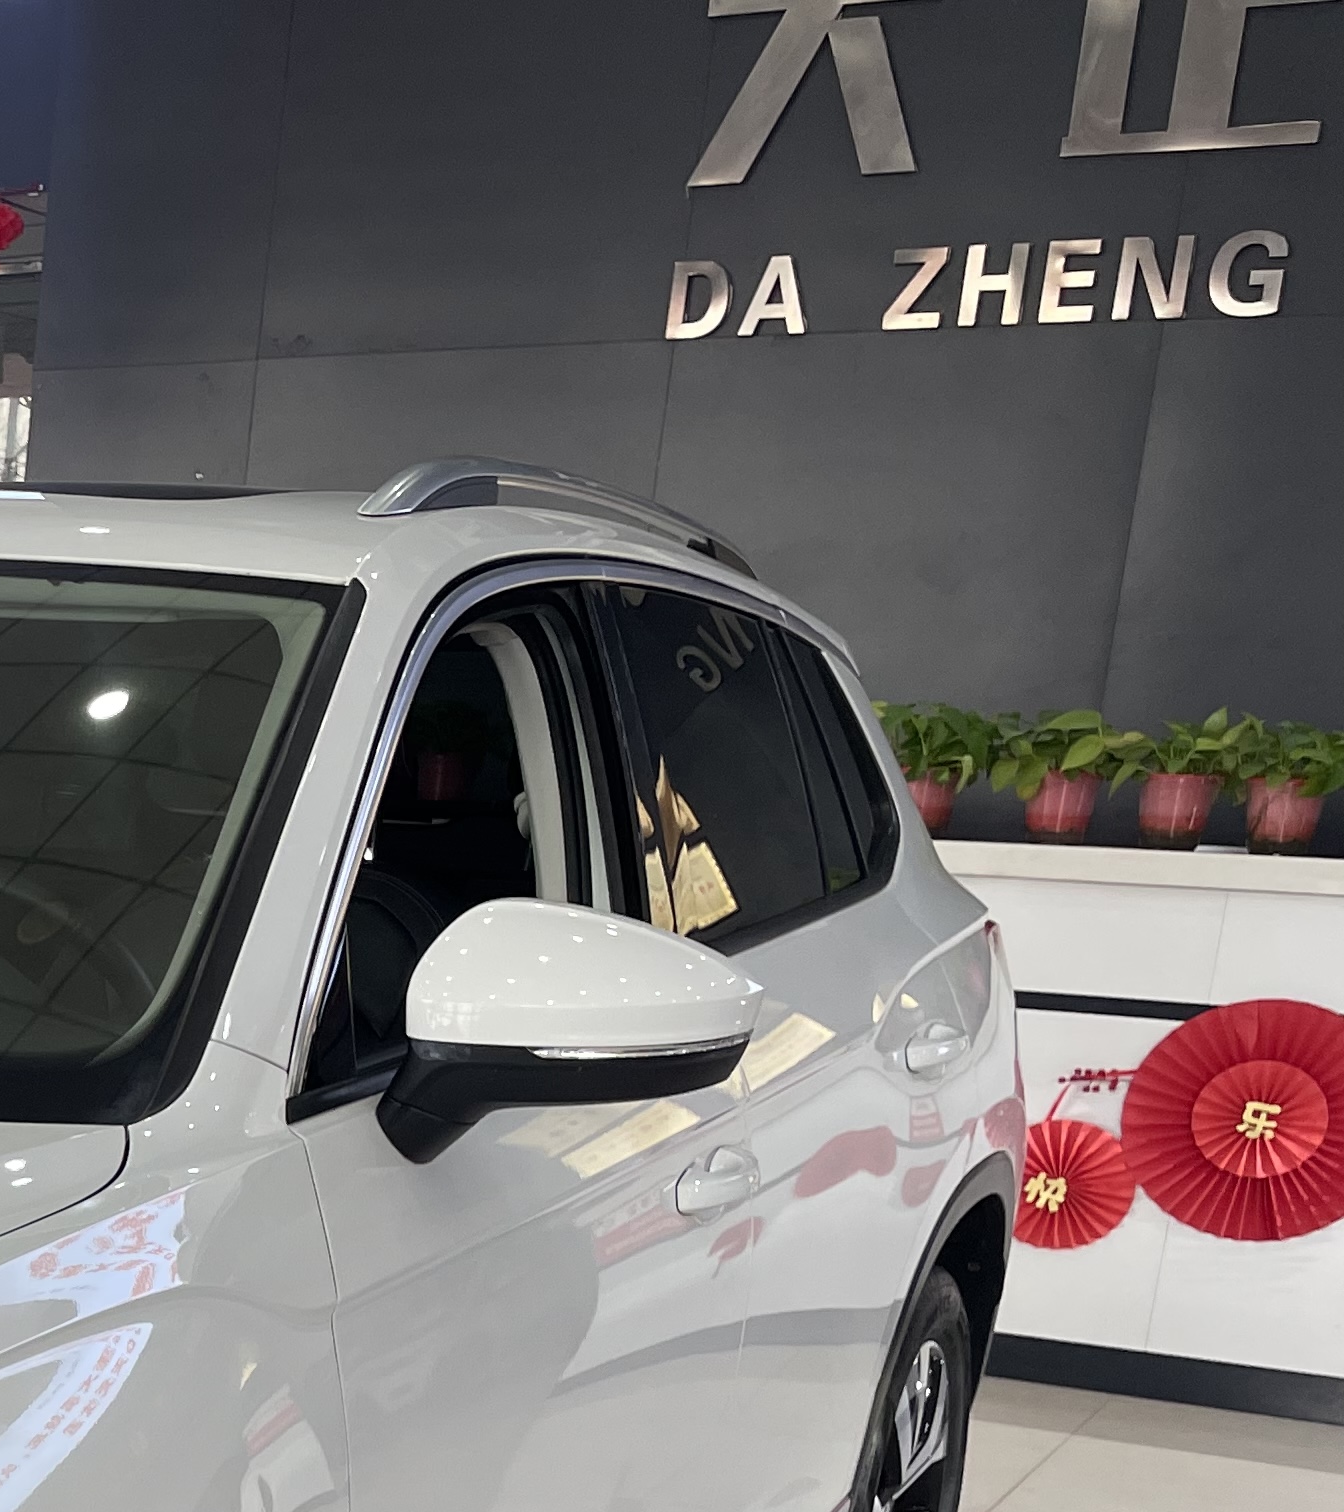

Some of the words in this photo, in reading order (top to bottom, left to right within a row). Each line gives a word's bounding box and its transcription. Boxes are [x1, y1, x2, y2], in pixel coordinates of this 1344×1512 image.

[664, 254, 809, 341] DA
[880, 229, 1290, 331] ZHENG
[1236, 1101, 1282, 1139] 乐
